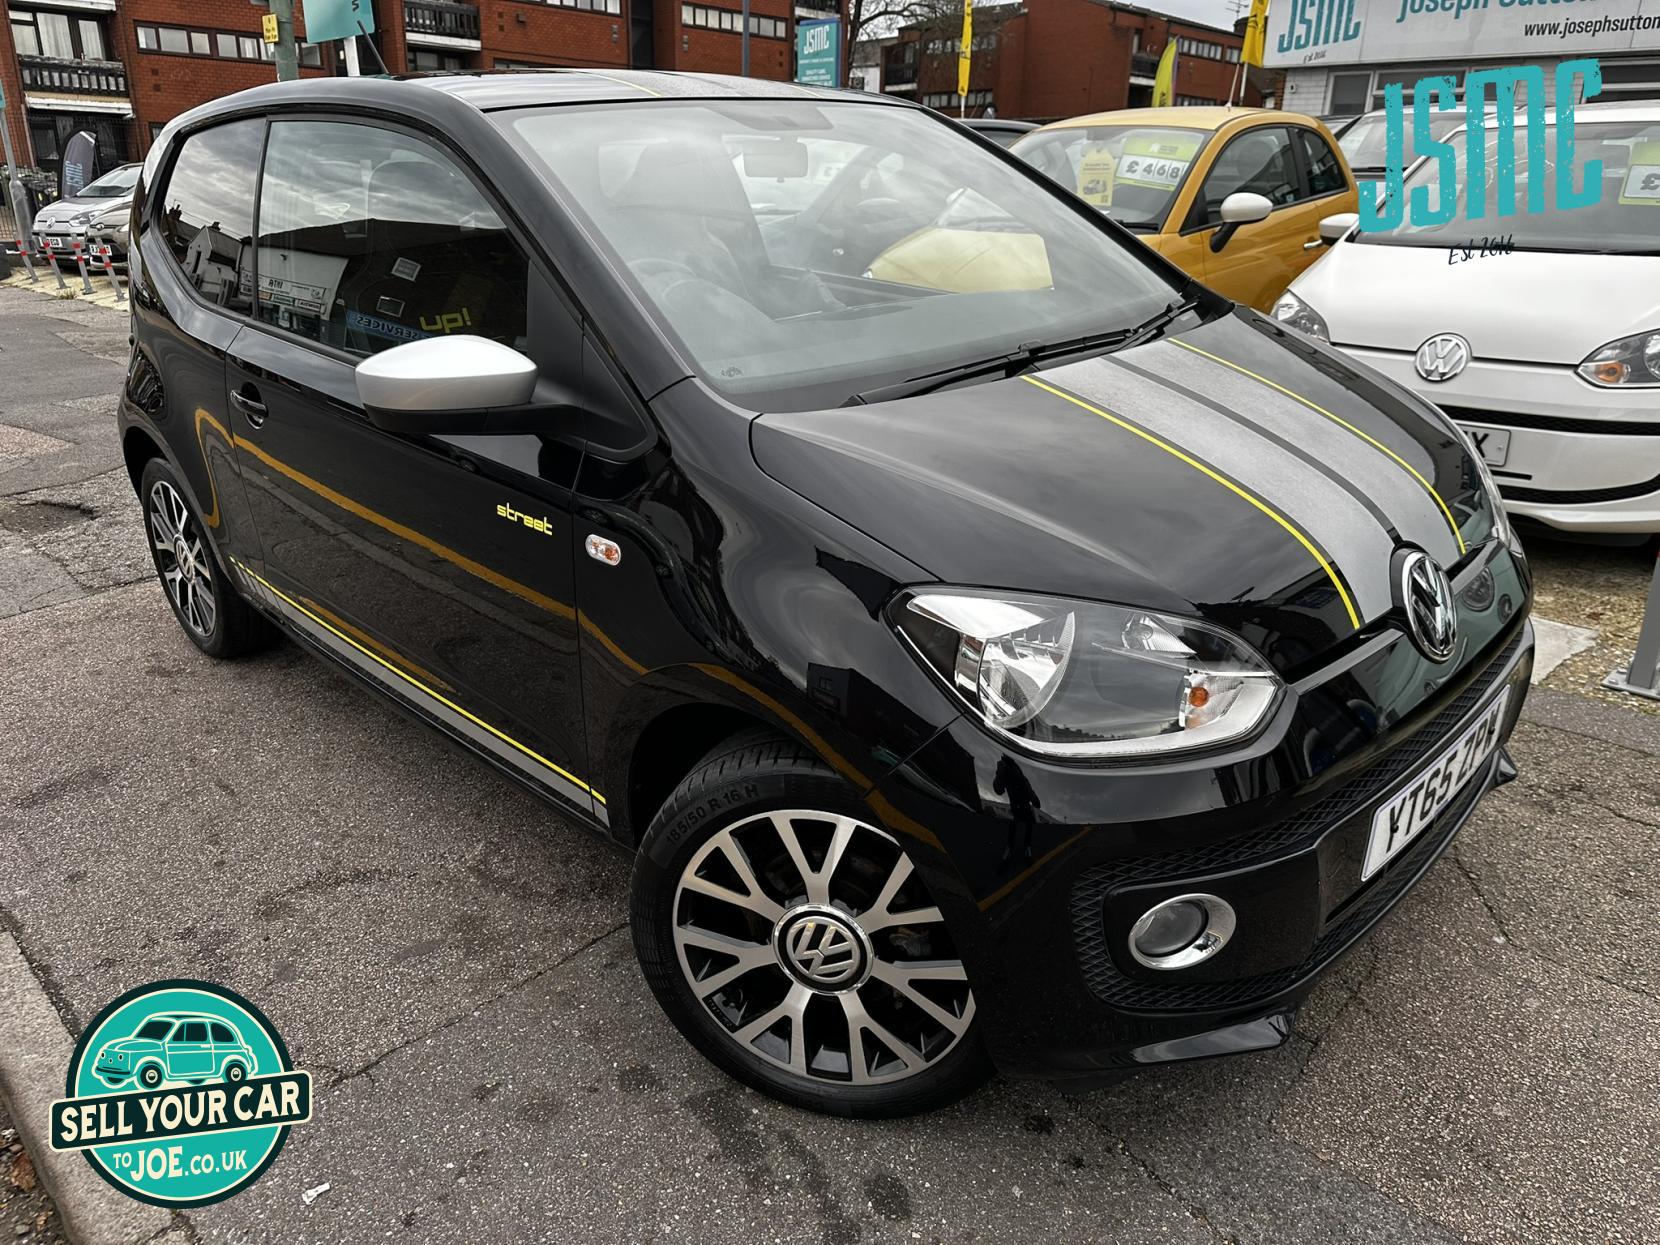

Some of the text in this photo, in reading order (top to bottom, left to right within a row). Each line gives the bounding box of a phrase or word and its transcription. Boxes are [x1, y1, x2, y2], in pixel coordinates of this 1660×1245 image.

[803, 25, 830, 54] JSMC
[419, 307, 472, 334] up!
[496, 502, 553, 536] street
[665, 806, 706, 847] 185/50
[723, 789, 742, 805] 16
[1386, 749, 1458, 853] YT65
